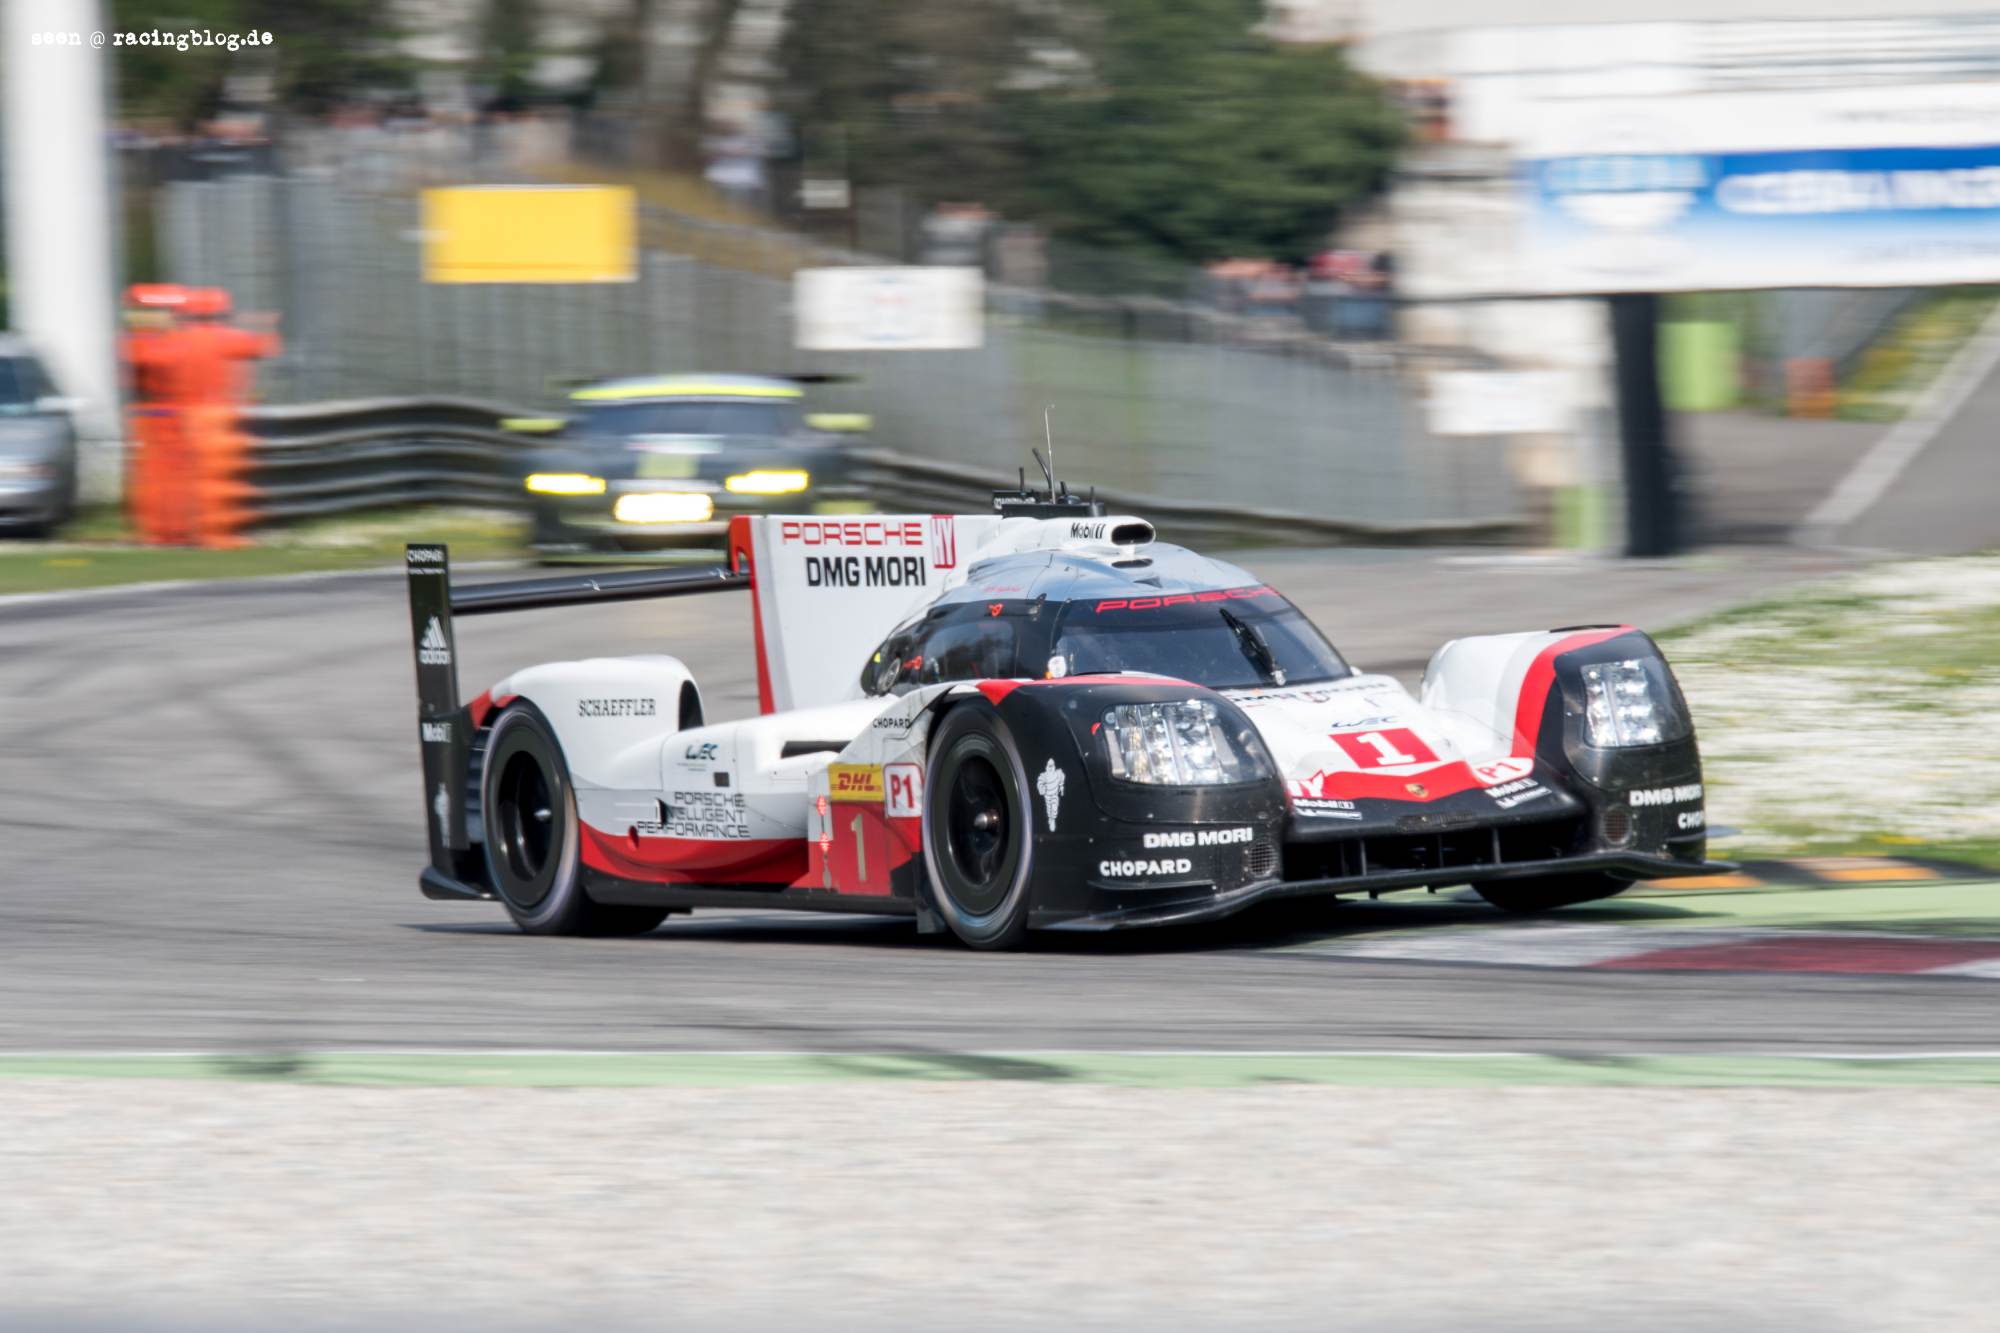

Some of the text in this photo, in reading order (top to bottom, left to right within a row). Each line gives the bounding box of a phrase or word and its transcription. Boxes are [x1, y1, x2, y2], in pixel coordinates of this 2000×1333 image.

[782, 522, 923, 545] PORSCHE
[805, 556, 926, 586] DMG MORI
[578, 698, 656, 717] SCHAEFFLER
[872, 717, 911, 729] CHOPARD
[1356, 732, 1416, 765] 1
[837, 772, 875, 791] DHL
[674, 792, 745, 807] PORSCHE
[889, 774, 915, 809] P1
[1629, 787, 1674, 806] DMG
[636, 821, 751, 838] PERFORMANCE
[1143, 827, 1253, 848] DMG MORI
[850, 813, 867, 881] 1
[1099, 858, 1192, 877] CHOPARD
